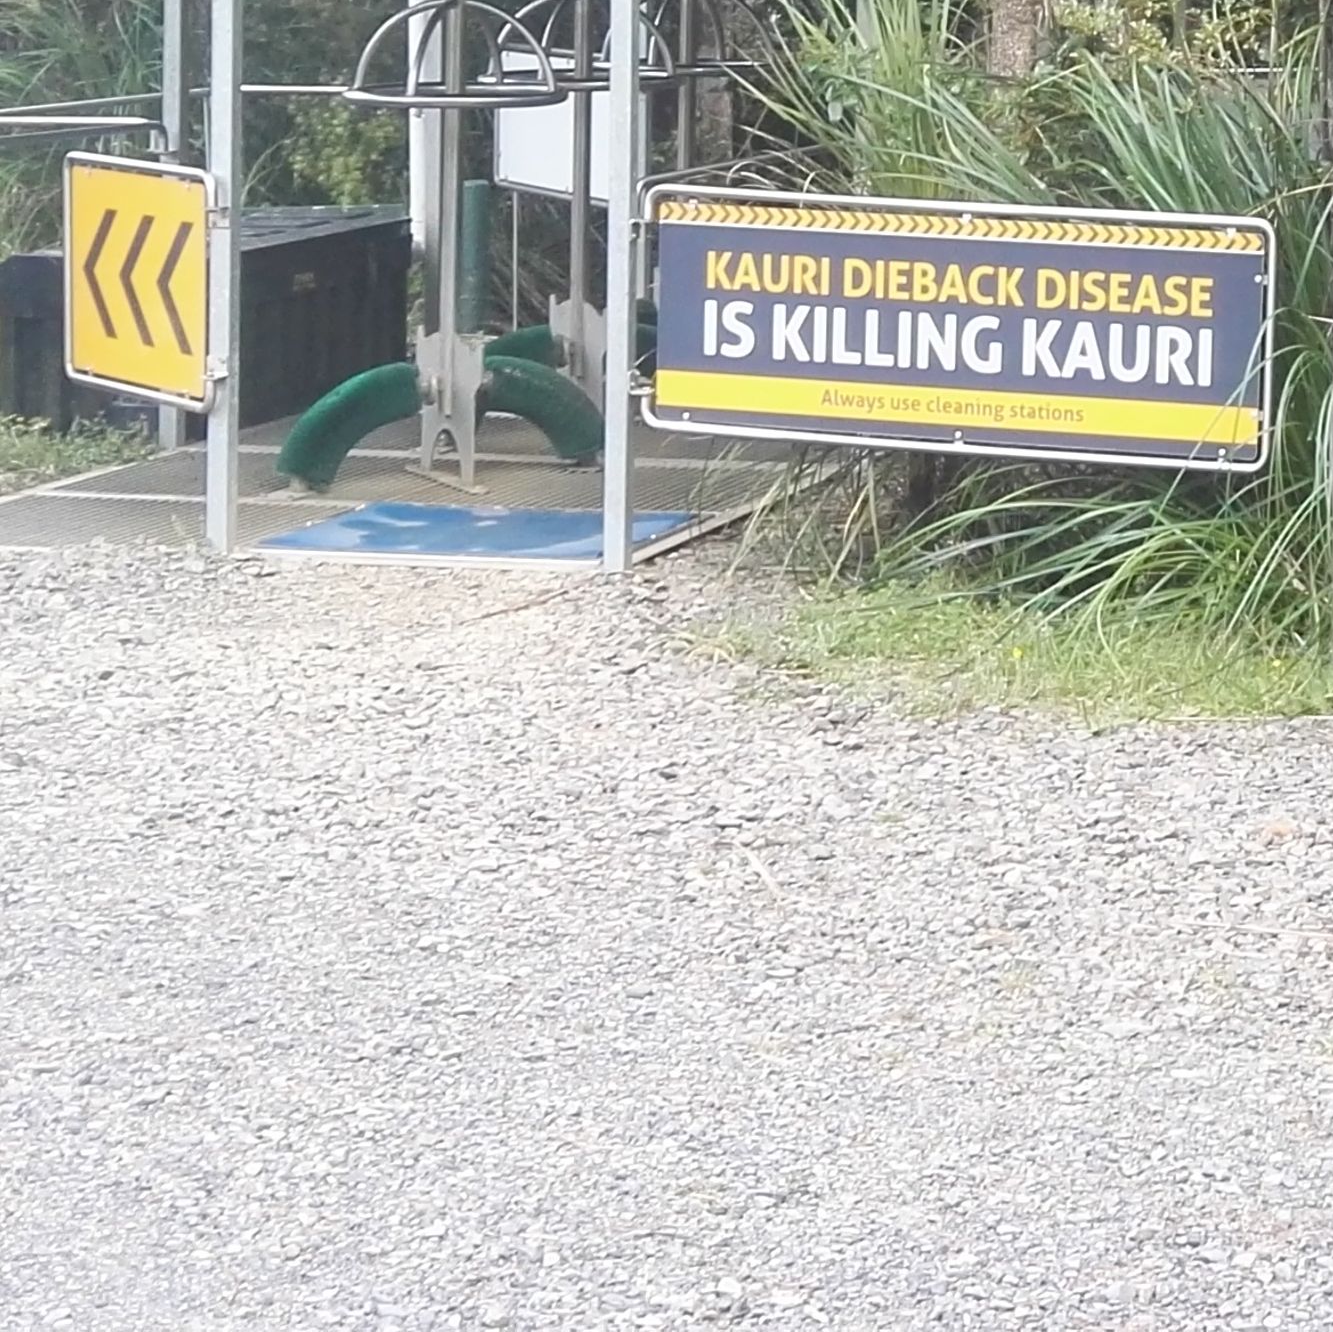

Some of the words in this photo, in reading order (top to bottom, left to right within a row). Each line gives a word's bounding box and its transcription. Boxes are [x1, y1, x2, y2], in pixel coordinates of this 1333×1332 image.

[705, 250, 829, 296] KAURI
[843, 258, 1024, 307] DIEBACK
[1037, 268, 1213, 317] DISEASE
[703, 300, 755, 357] IS
[772, 304, 1002, 373] KILLING
[1022, 317, 1212, 387] KAURI
[821, 388, 886, 411] Always
[890, 398, 921, 412] use
[926, 394, 1005, 422] cleaning
[1009, 401, 1085, 422] stations
